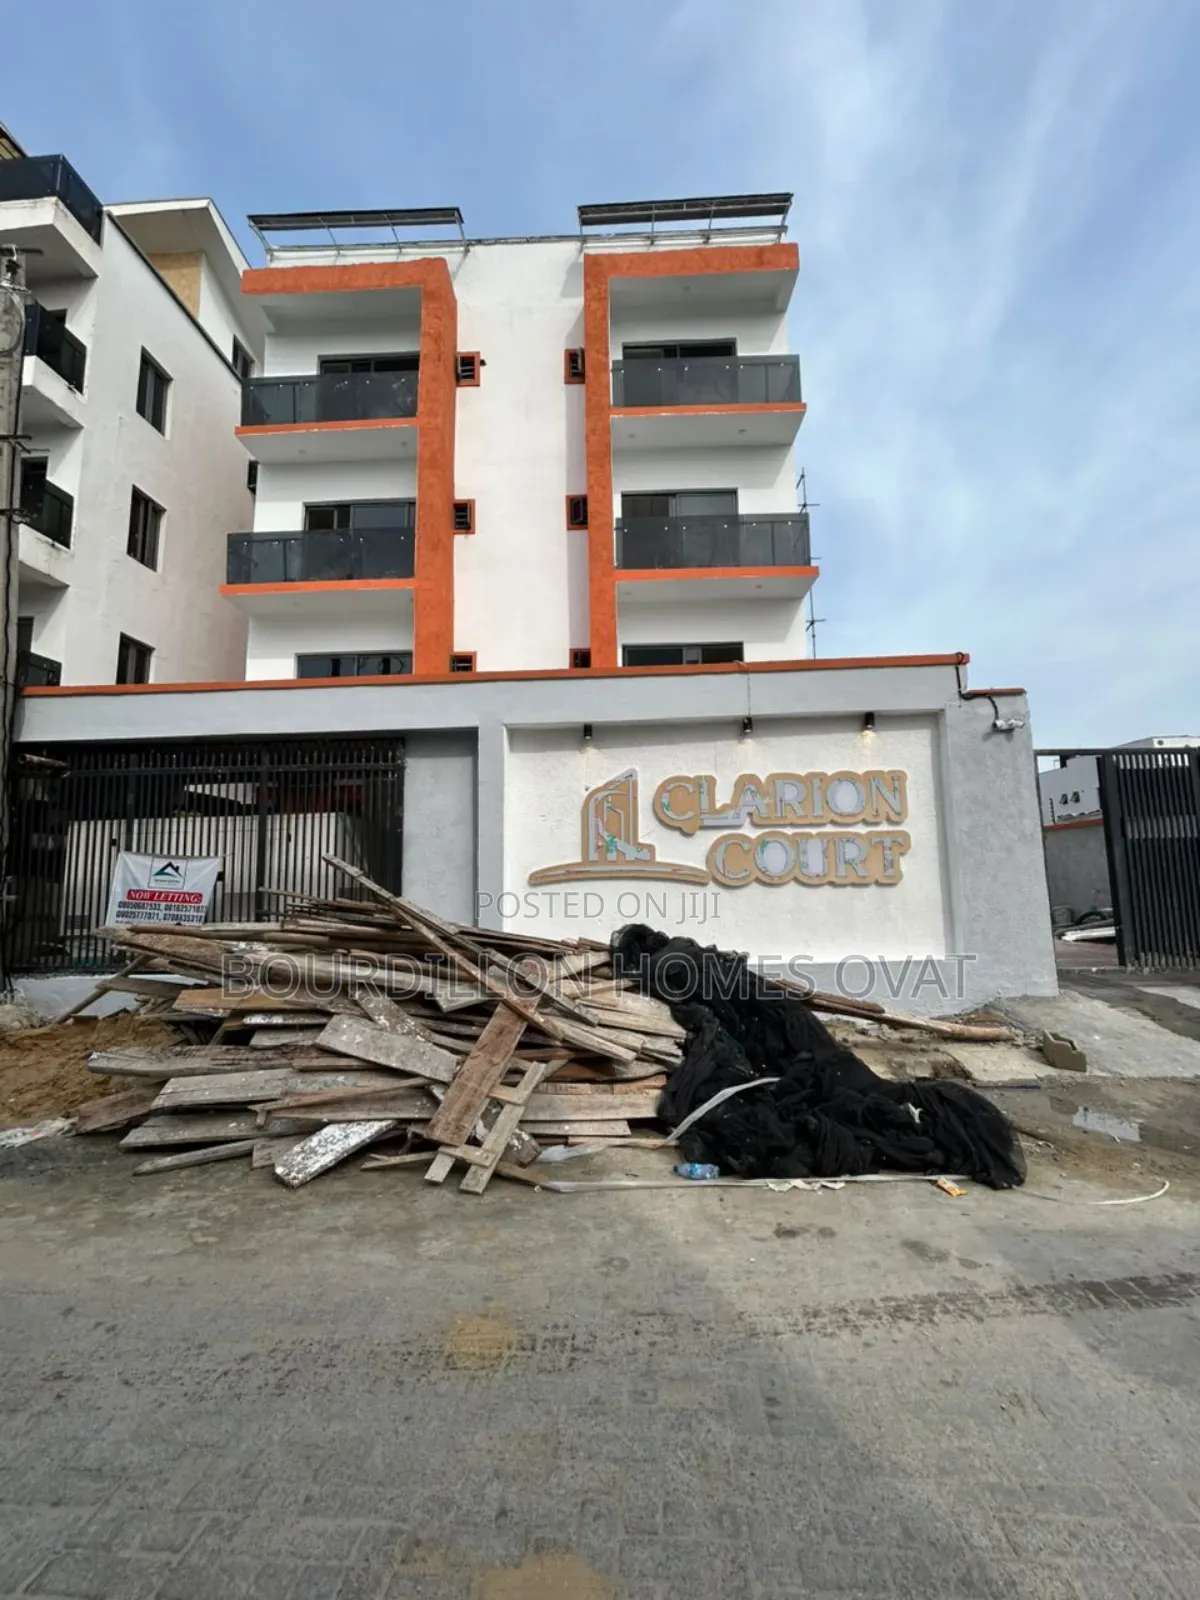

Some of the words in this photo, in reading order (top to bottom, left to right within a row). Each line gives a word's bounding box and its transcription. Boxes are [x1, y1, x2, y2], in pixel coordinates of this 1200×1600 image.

[657, 774, 904, 831] CLARION
[710, 834, 907, 883] COURT
[129, 890, 150, 900] NOW
